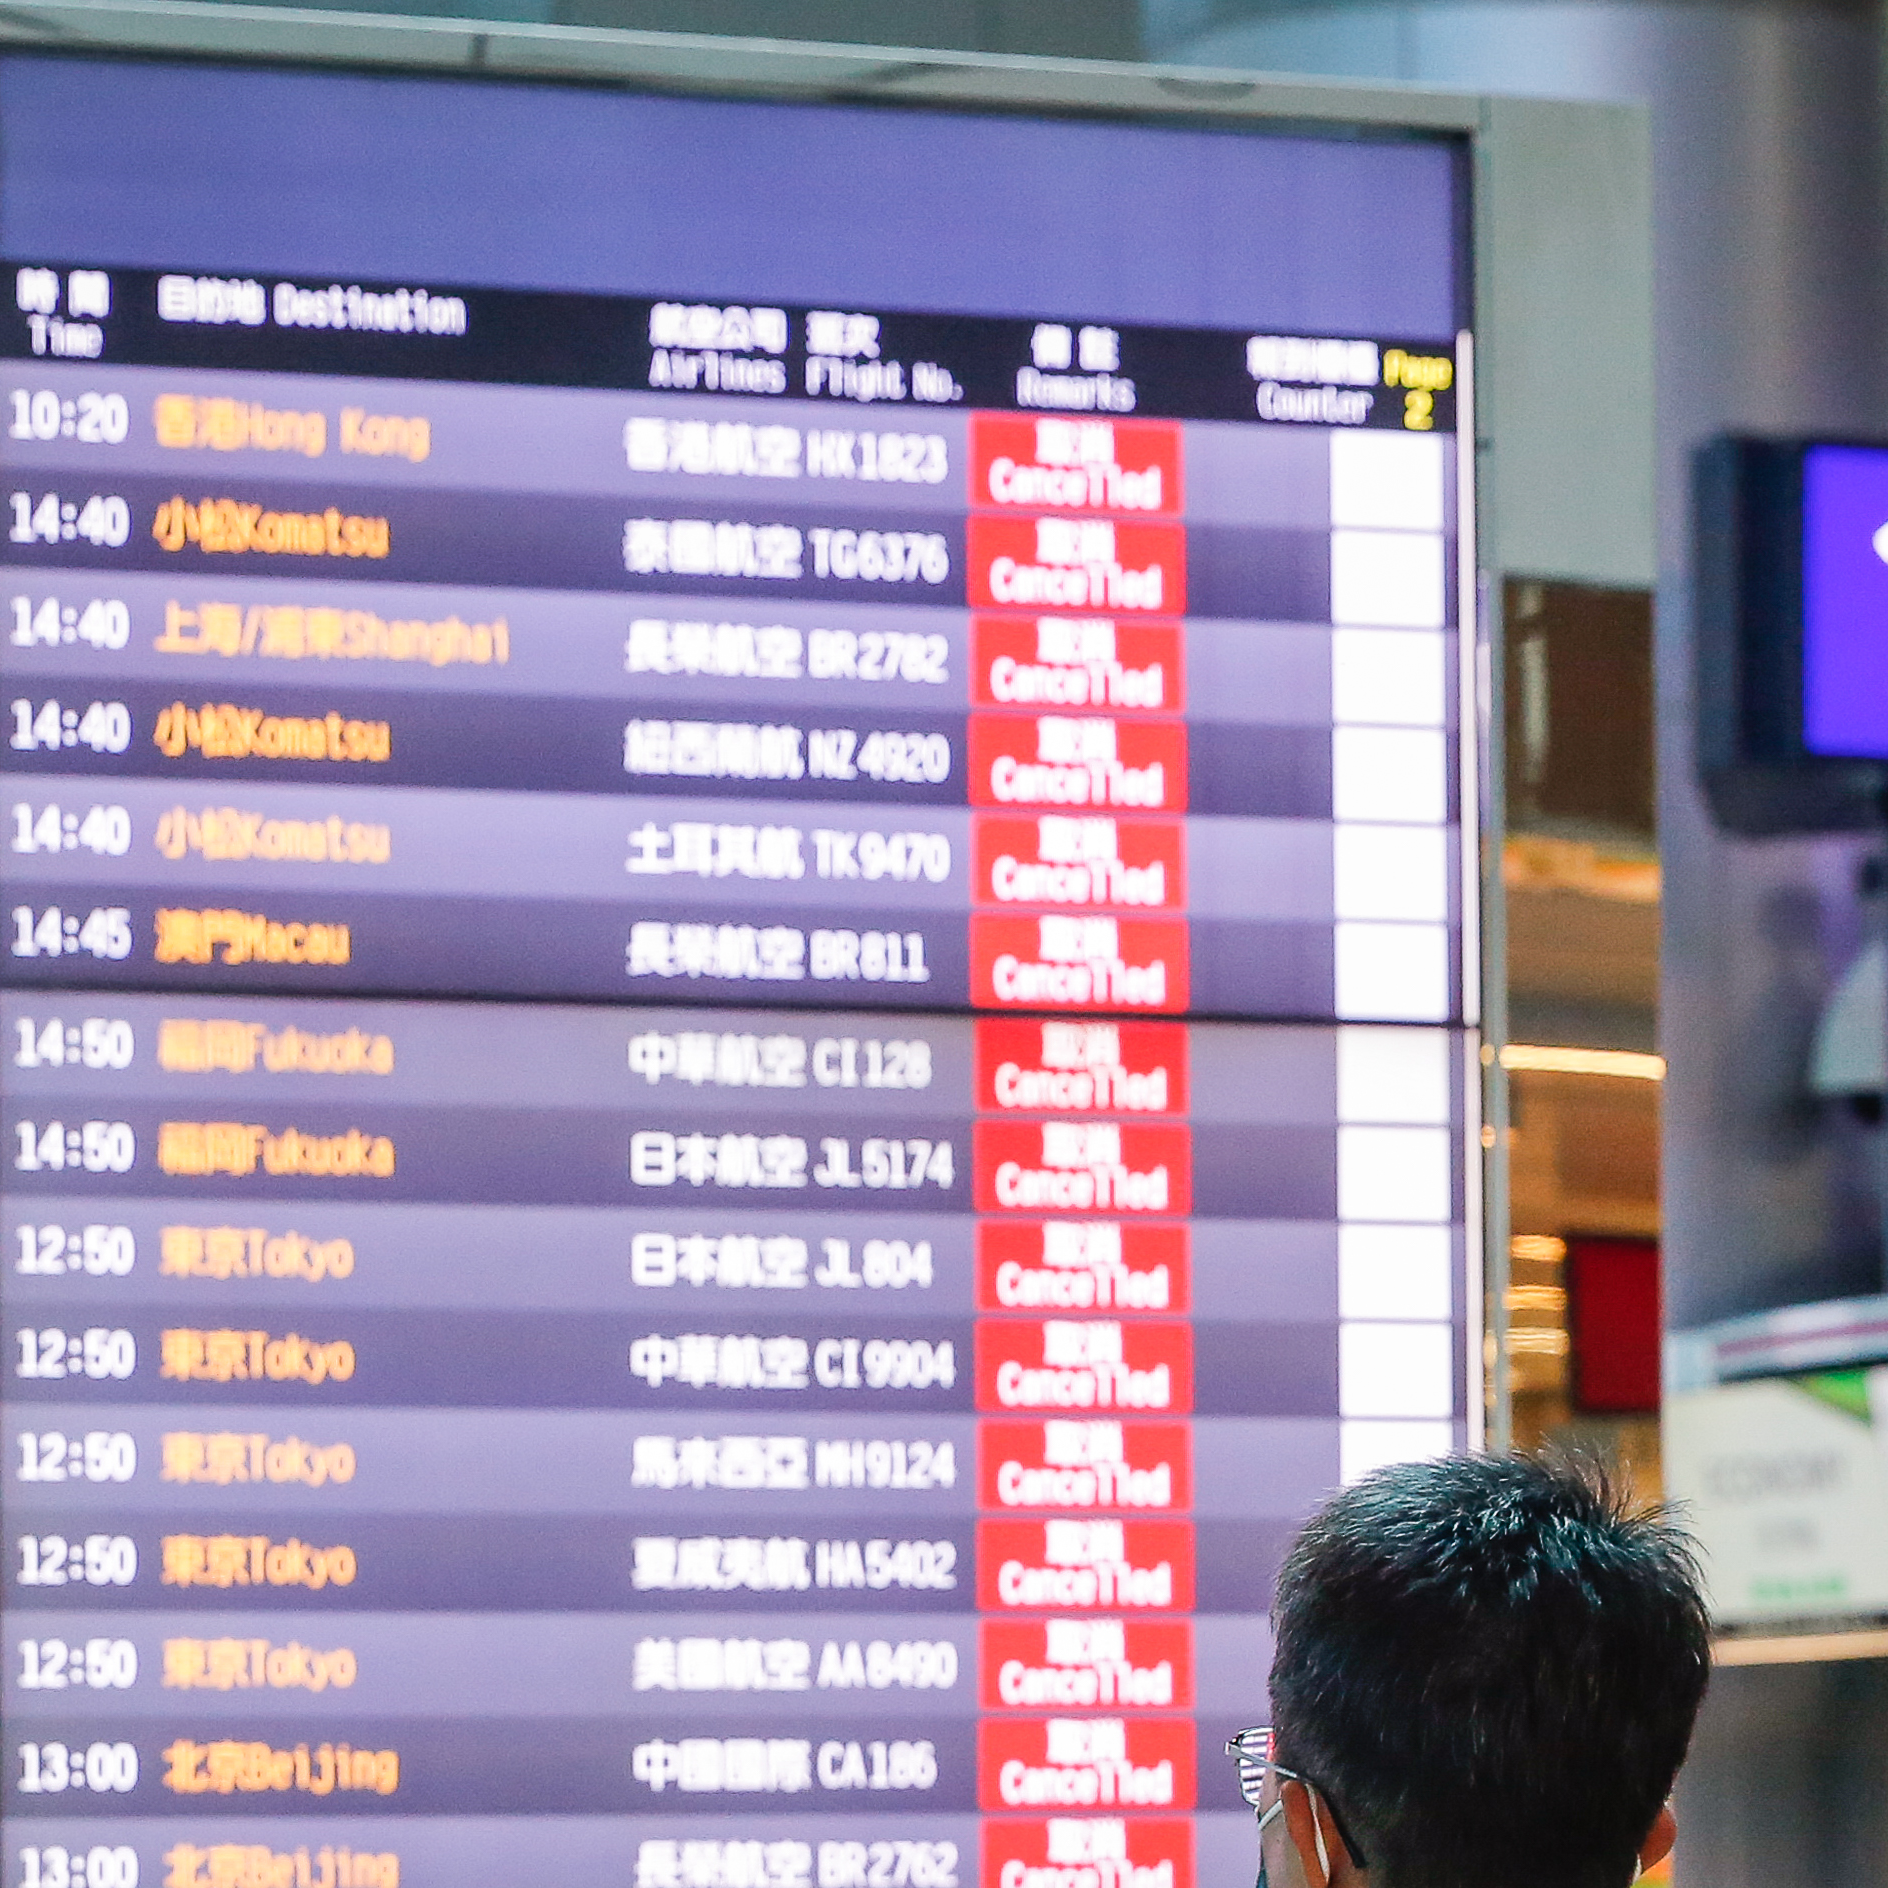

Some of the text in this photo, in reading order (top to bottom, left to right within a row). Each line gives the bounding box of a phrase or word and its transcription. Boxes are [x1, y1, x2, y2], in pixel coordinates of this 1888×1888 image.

[275, 283, 466, 333] Destination
[29, 312, 102, 357] Time
[12, 390, 128, 442] 10:20
[1404, 388, 1434, 430] 2
[990, 457, 1161, 509] Cancelled
[11, 492, 949, 582] 14:40 TG6376
[13, 597, 128, 648] 14:40
[12, 699, 130, 752] 14:40
[15, 803, 950, 882] 14:40 TK9470
[13, 906, 130, 958] 14:45
[17, 1019, 133, 1068] 14:50
[813, 1039, 931, 1088] CI128
[17, 1121, 954, 1188] 14:50 JL5174
[18, 1225, 134, 1274] 12:50
[815, 1239, 932, 1287] JL804
[997, 1262, 1168, 1308] Cancelled
[18, 1328, 135, 1378] 12:50
[815, 1339, 955, 1388] CI9904
[20, 1432, 136, 1481] 12:50
[19, 1535, 956, 1588] 12:50 HA5402
[21, 1639, 136, 1688] 12:50
[20, 1743, 138, 1791] 13:00
[818, 1741, 936, 1788] CA186
[819, 1841, 958, 1888] BR2762
